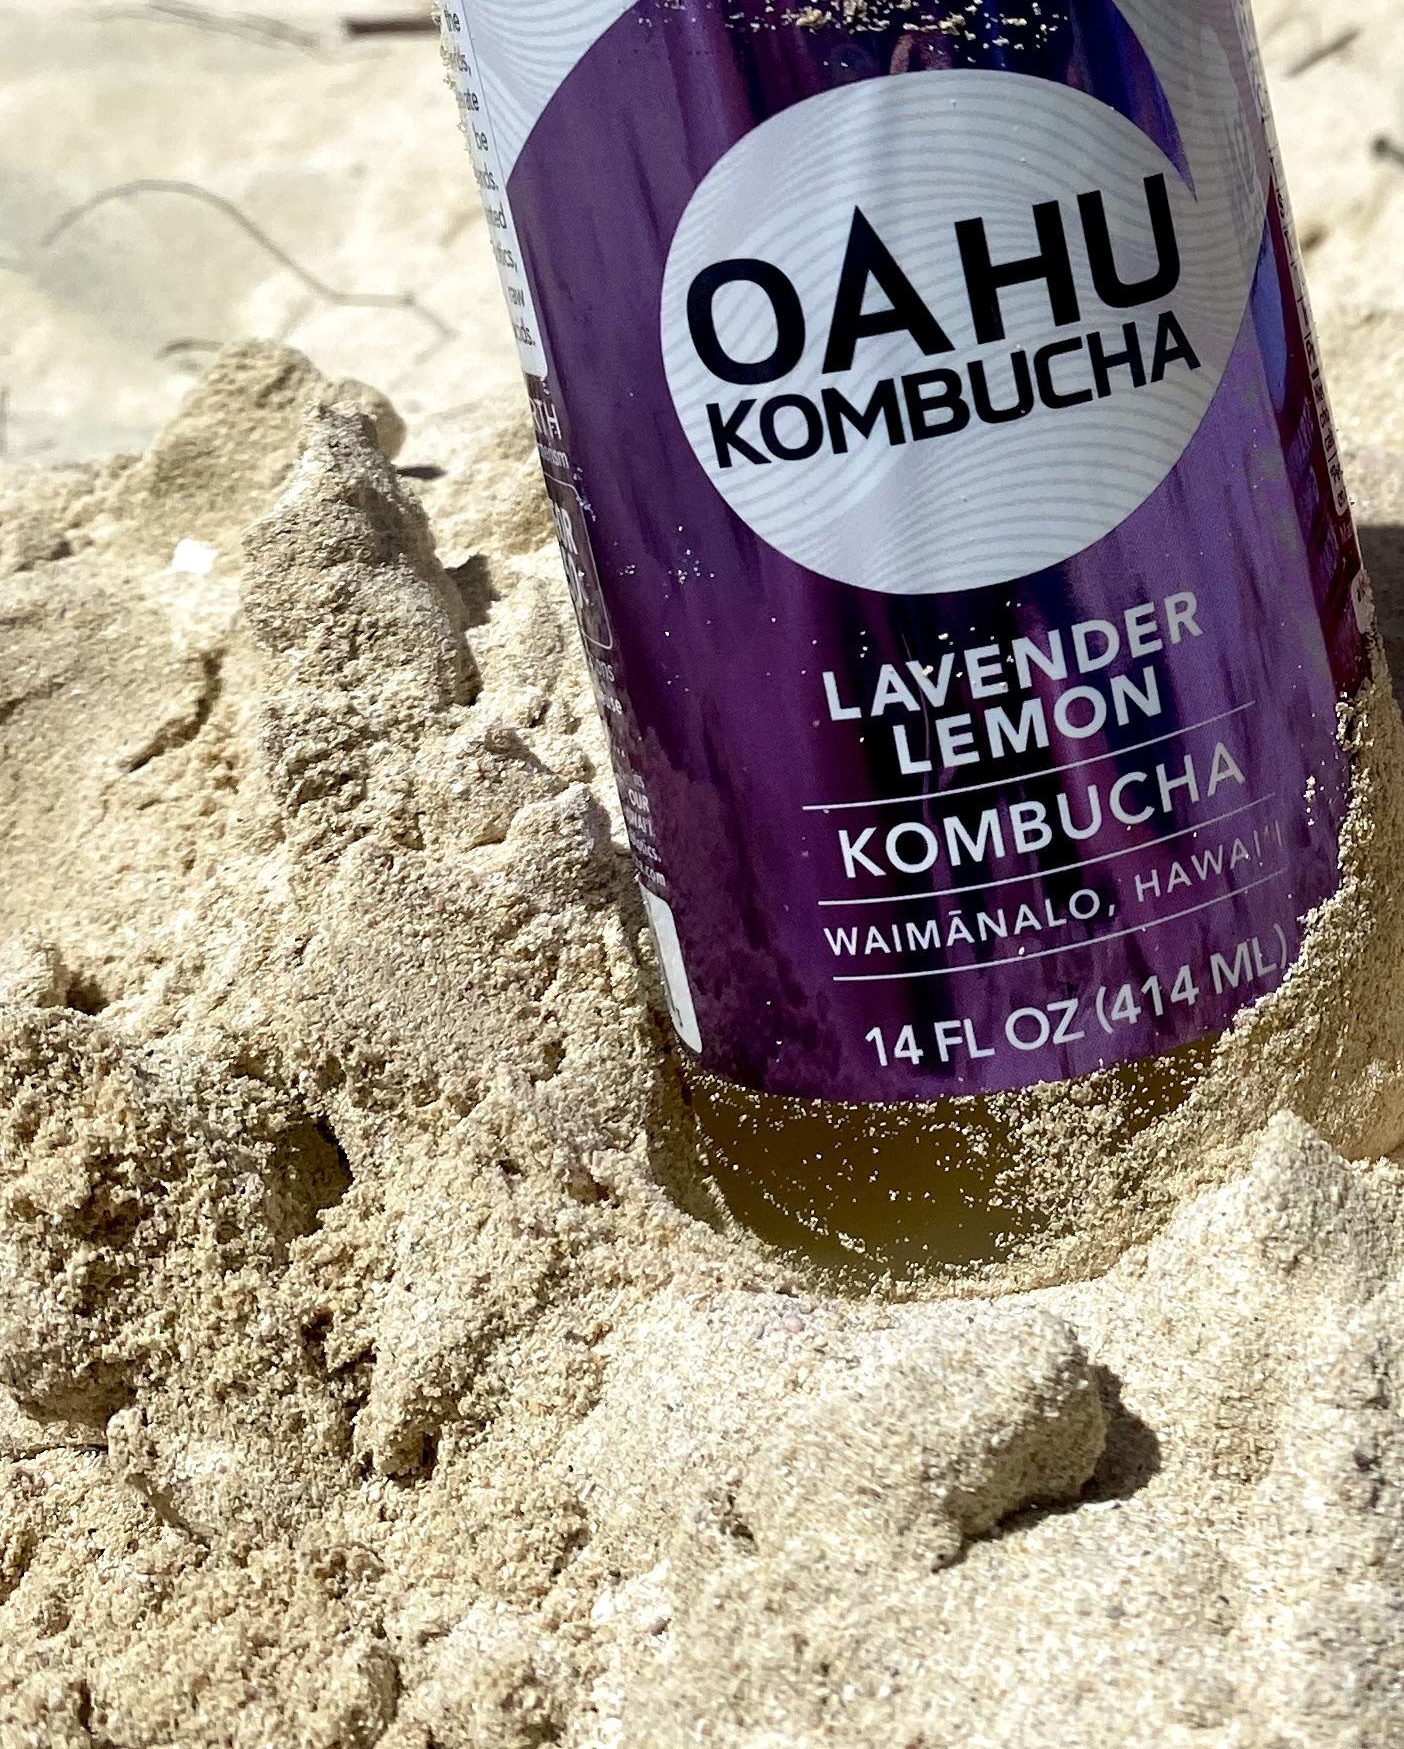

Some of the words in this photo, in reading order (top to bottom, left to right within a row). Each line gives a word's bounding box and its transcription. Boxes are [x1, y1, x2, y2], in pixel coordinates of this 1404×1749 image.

[686, 173, 1181, 384] OAHU
[706, 310, 1201, 468] KOMBUCHA
[822, 591, 1203, 721] LAVENDER
[892, 666, 1162, 775] LEMON
[838, 742, 1245, 879] KOMBUCHA
[823, 888, 1116, 957] WAIMĀNALO,
[865, 1026, 924, 1067] 14
[935, 1019, 996, 1063] FL
[1004, 999, 1085, 1051] OZ
[1095, 963, 1200, 1035] (414
[1210, 922, 1287, 995] ML)
